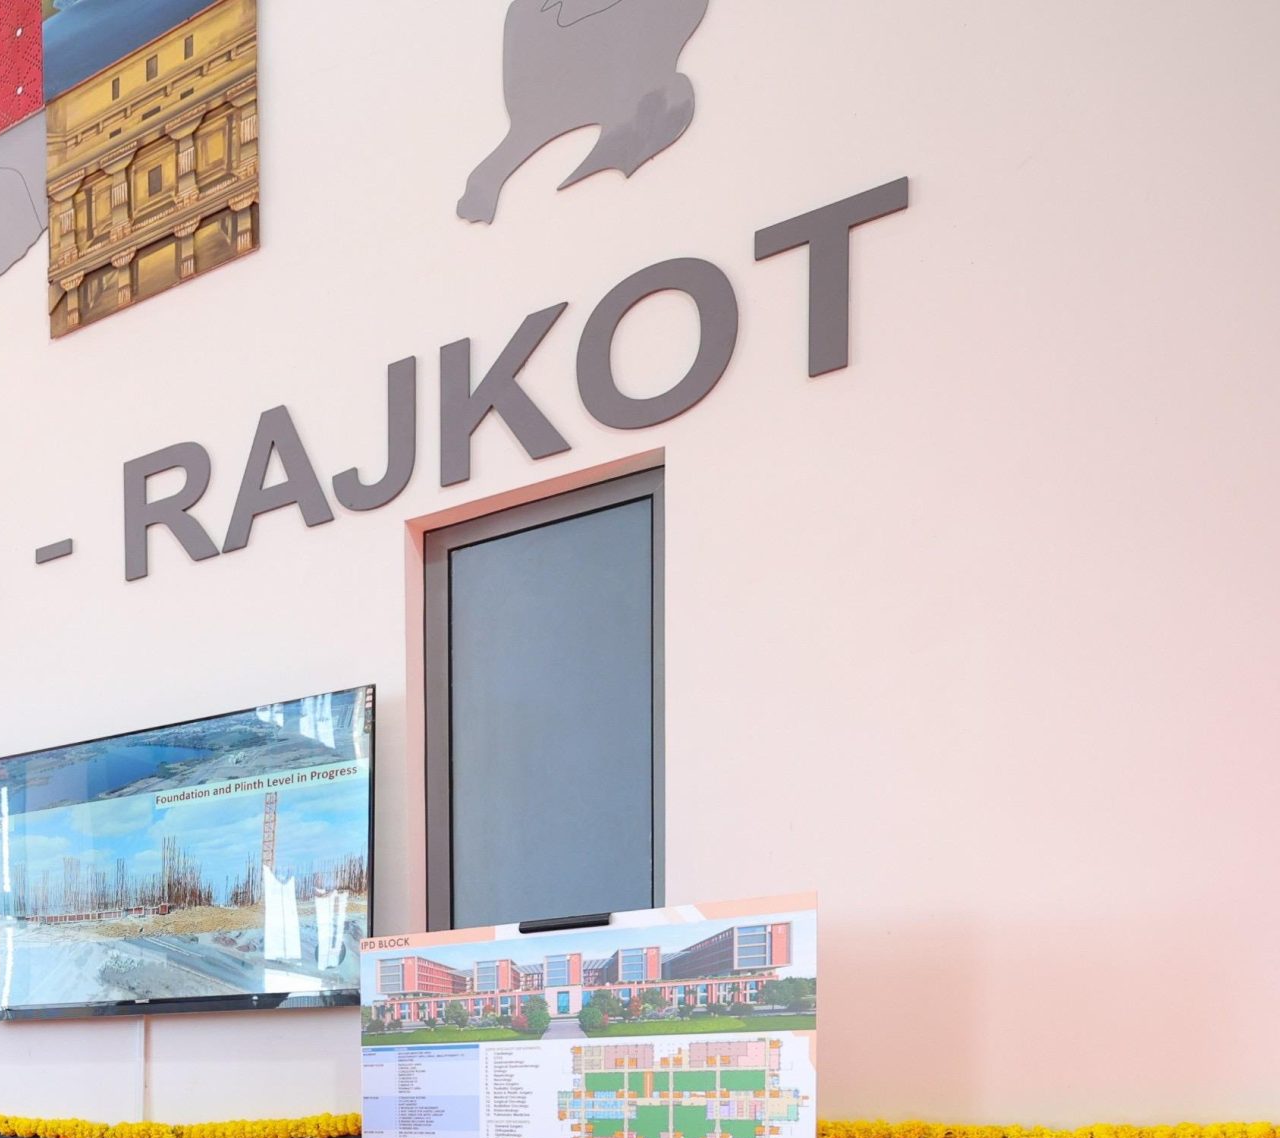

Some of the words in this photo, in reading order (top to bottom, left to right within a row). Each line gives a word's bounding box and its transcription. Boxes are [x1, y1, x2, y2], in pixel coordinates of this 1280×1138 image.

[123, 176, 909, 582] RAJKOT
[155, 788, 210, 805] Foundation
[213, 784, 232, 796] and
[234, 779, 264, 793] Plinth
[267, 774, 294, 788] Level
[297, 772, 307, 783] in
[310, 766, 358, 781] Progress
[361, 941, 376, 950] IPD
[378, 937, 410, 949] BLOCK
